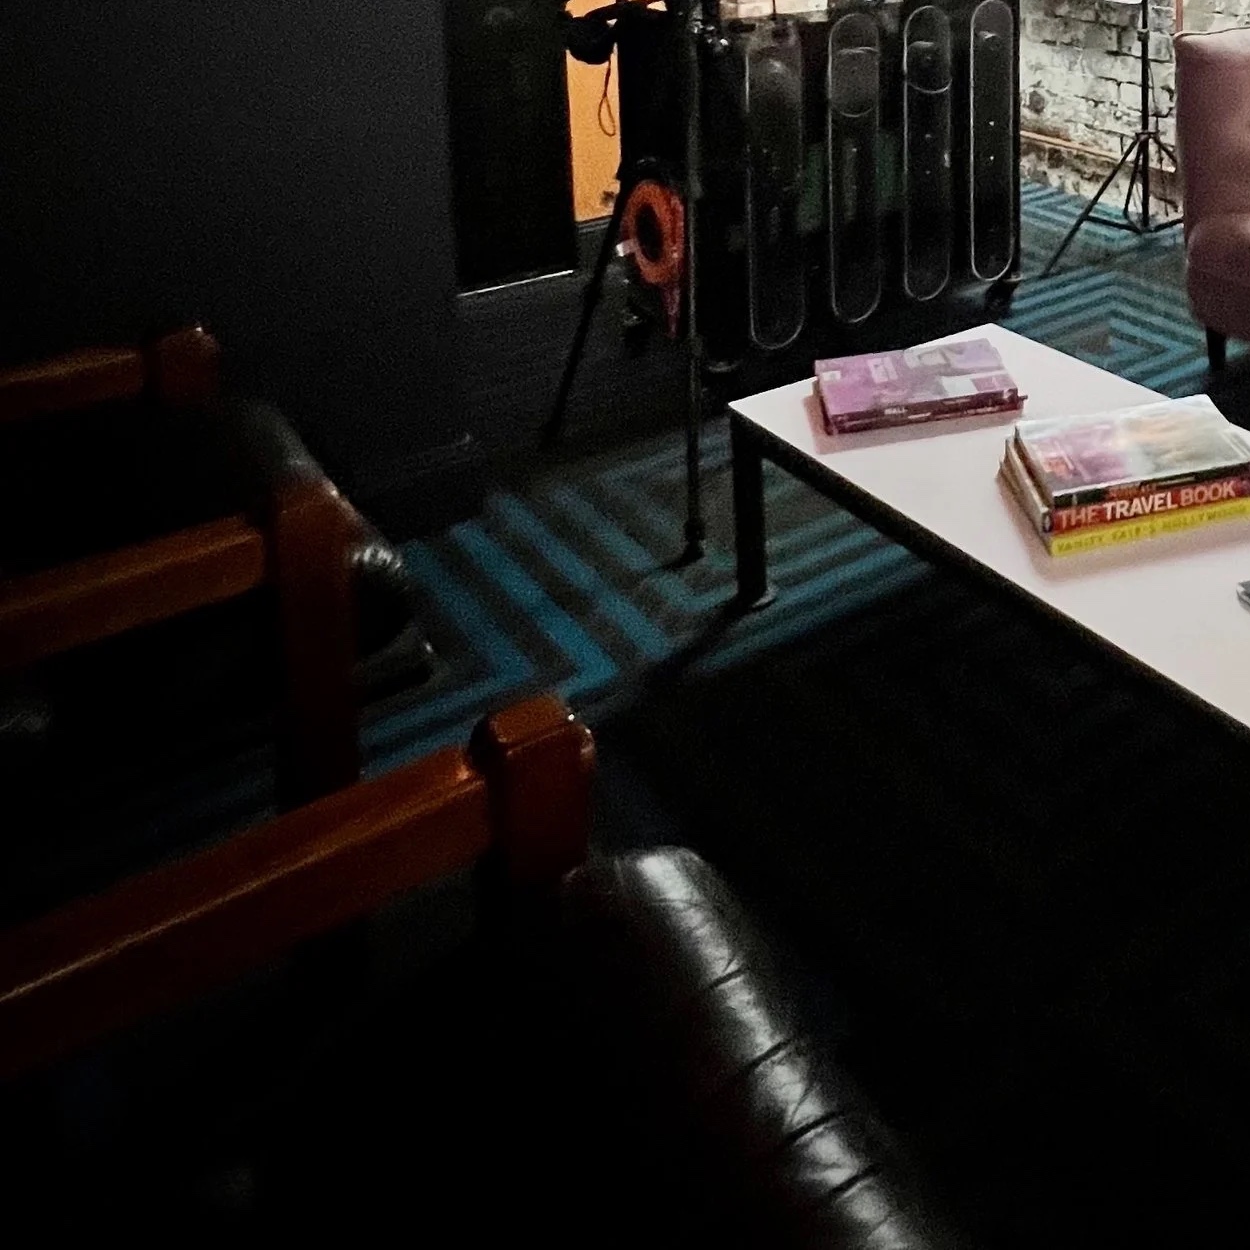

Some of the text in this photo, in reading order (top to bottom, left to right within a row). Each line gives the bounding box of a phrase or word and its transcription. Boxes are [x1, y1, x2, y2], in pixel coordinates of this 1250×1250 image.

[1059, 506, 1102, 531] THE
[1103, 491, 1178, 522] TRAVEL
[1180, 480, 1237, 507] BOOK
